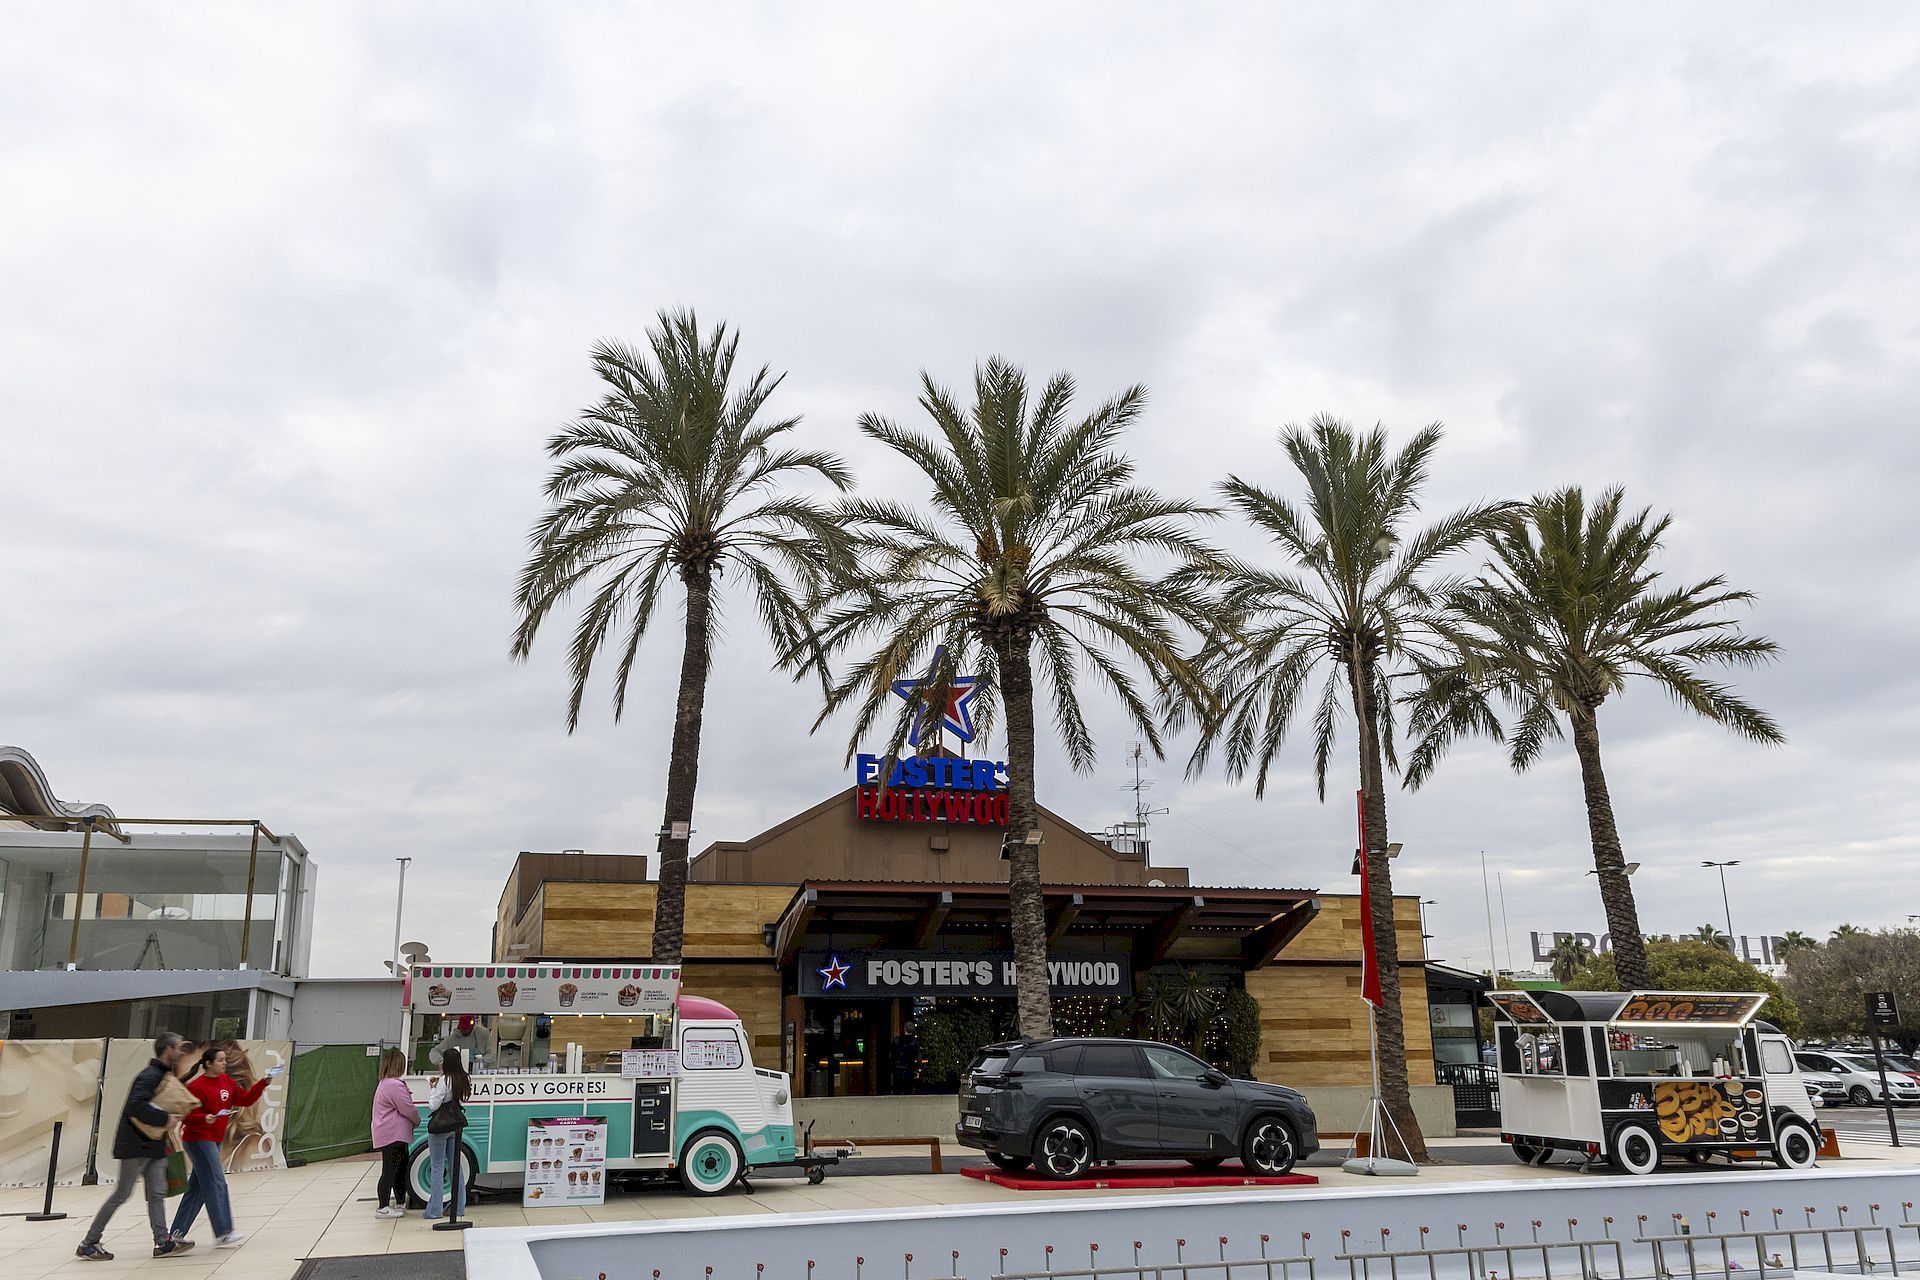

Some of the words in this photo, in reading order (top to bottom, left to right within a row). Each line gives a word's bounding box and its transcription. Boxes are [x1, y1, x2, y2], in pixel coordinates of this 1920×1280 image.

[857, 754, 1010, 791] FOSTER'
[857, 786, 1009, 826] HOLLYWOO
[867, 960, 993, 986] FOSTER'S
[1003, 961, 1120, 986] HYWOOD
[530, 1082, 539, 1095] Y
[543, 1081, 606, 1095] GOFRES!
